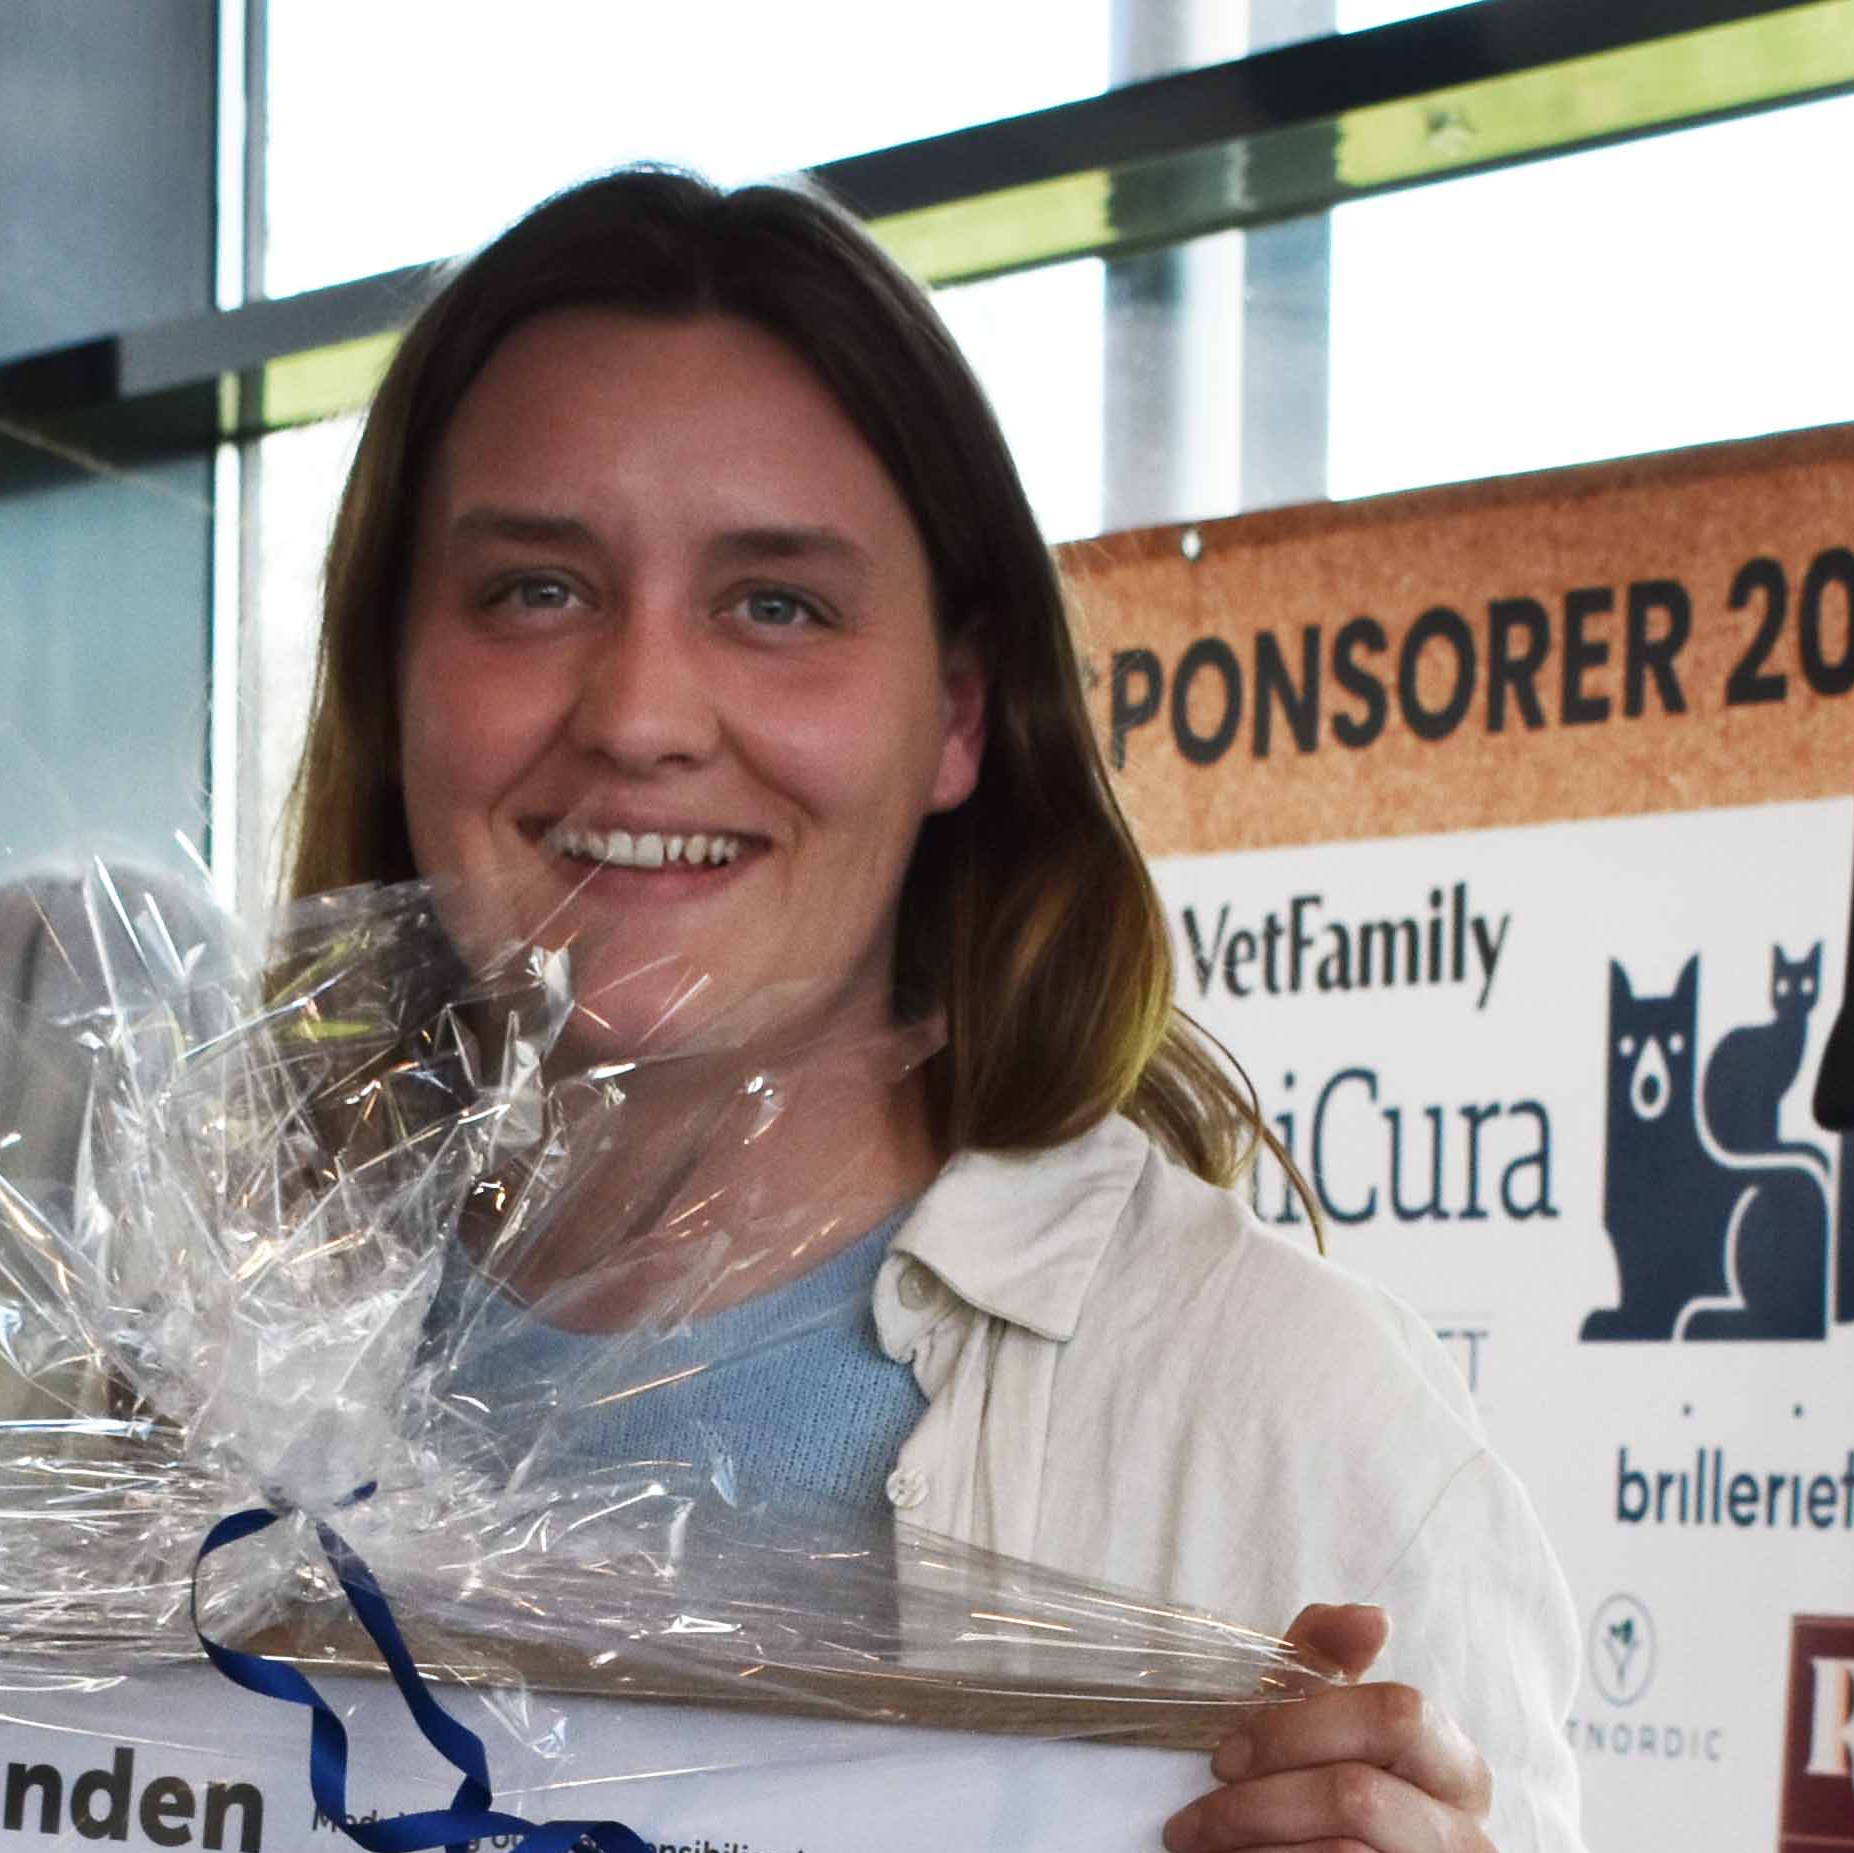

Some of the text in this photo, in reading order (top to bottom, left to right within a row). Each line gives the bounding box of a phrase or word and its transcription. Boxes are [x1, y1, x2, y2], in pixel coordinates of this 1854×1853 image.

[1085, 578, 1693, 770] PONSORER
[1182, 881, 1512, 1009] VetFamily
[1253, 1066, 1559, 1225] iCura
